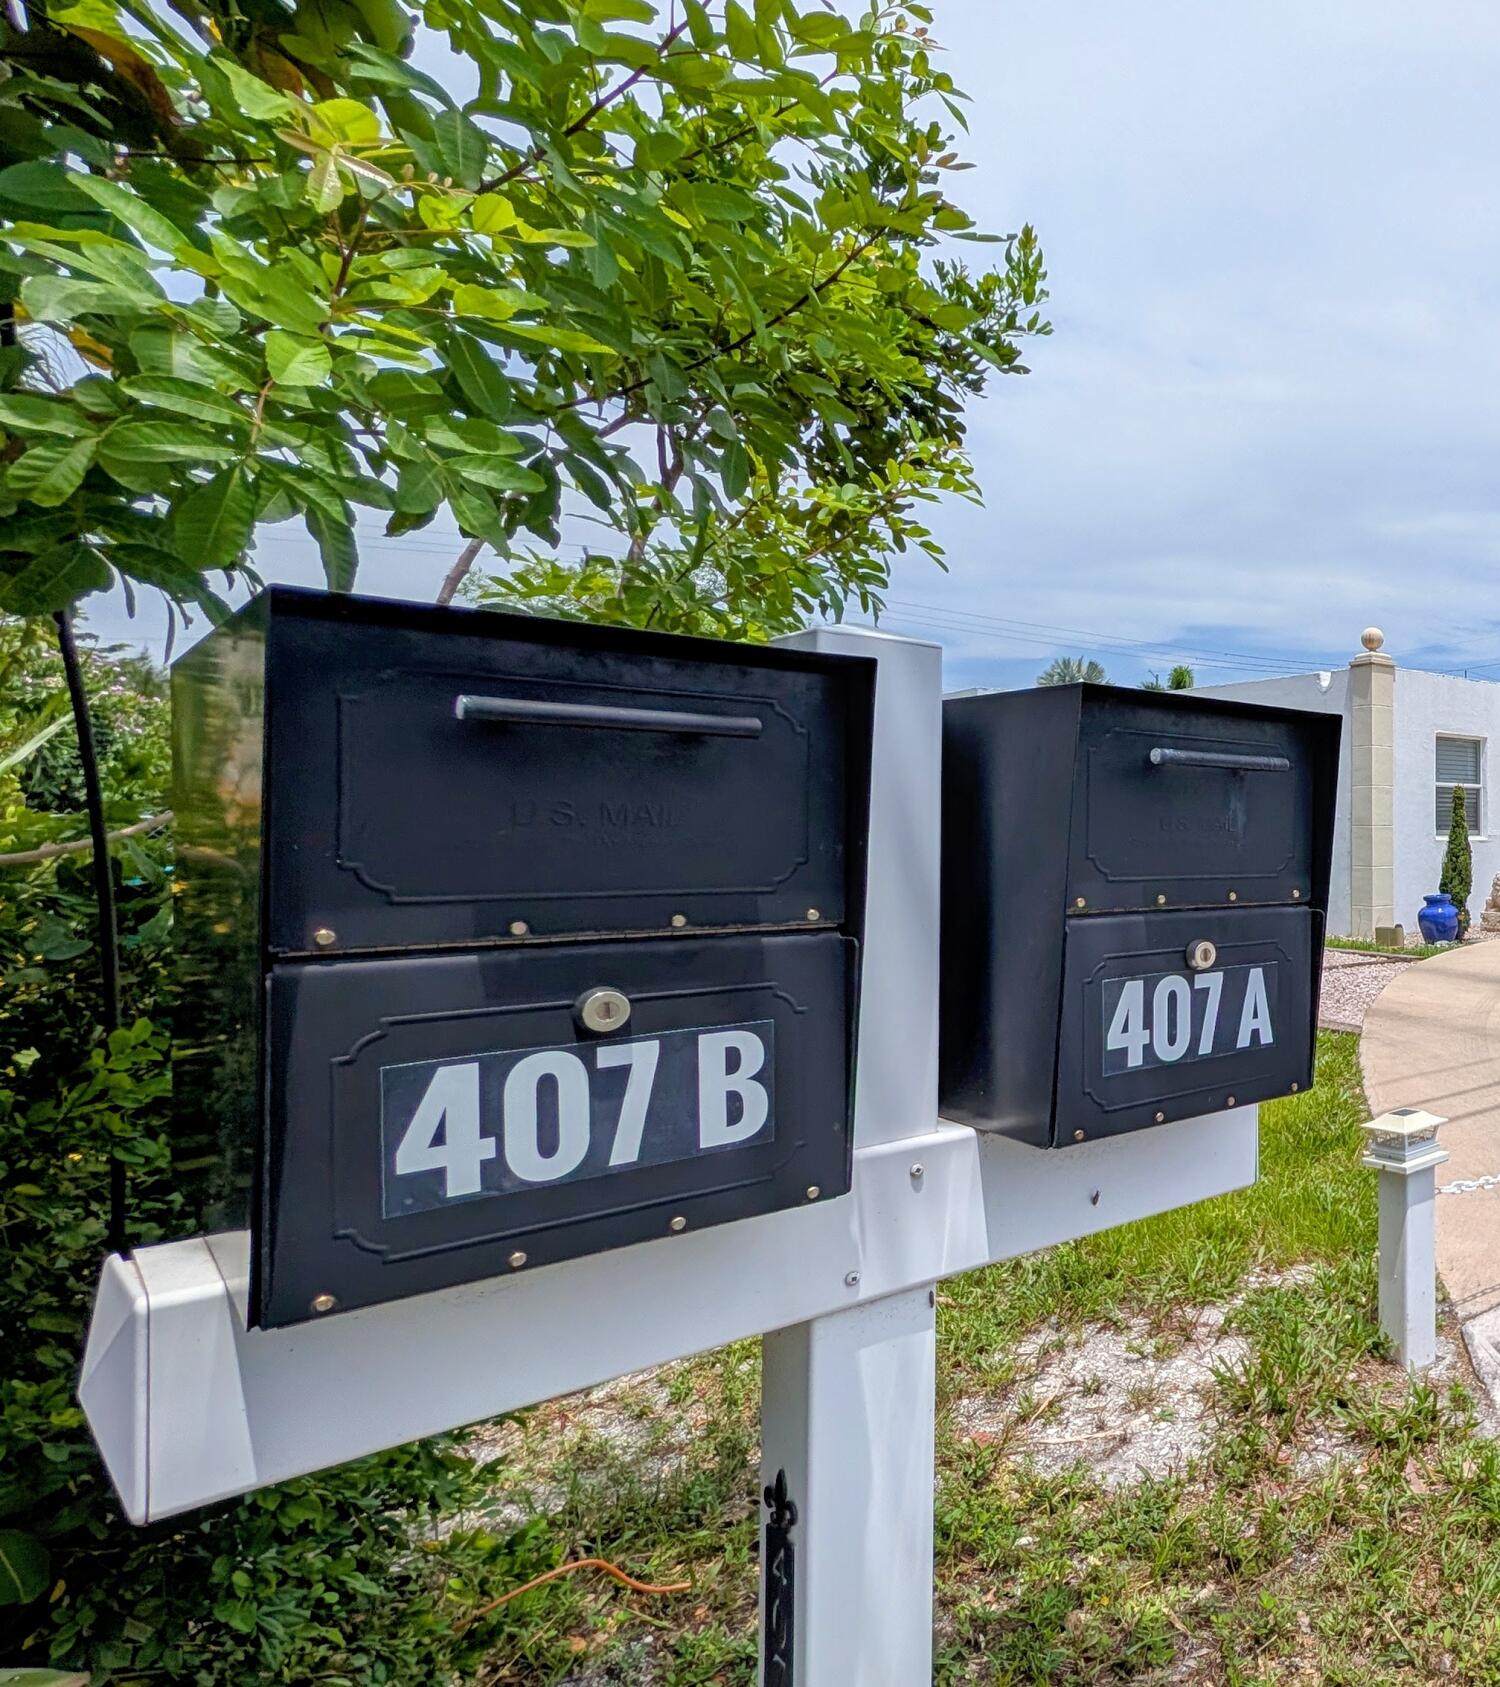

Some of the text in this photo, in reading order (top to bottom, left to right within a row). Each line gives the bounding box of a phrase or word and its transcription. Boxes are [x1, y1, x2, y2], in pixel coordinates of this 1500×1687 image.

[1107, 967, 1274, 1068] 407 A
[395, 1030, 769, 1198] 407 B
